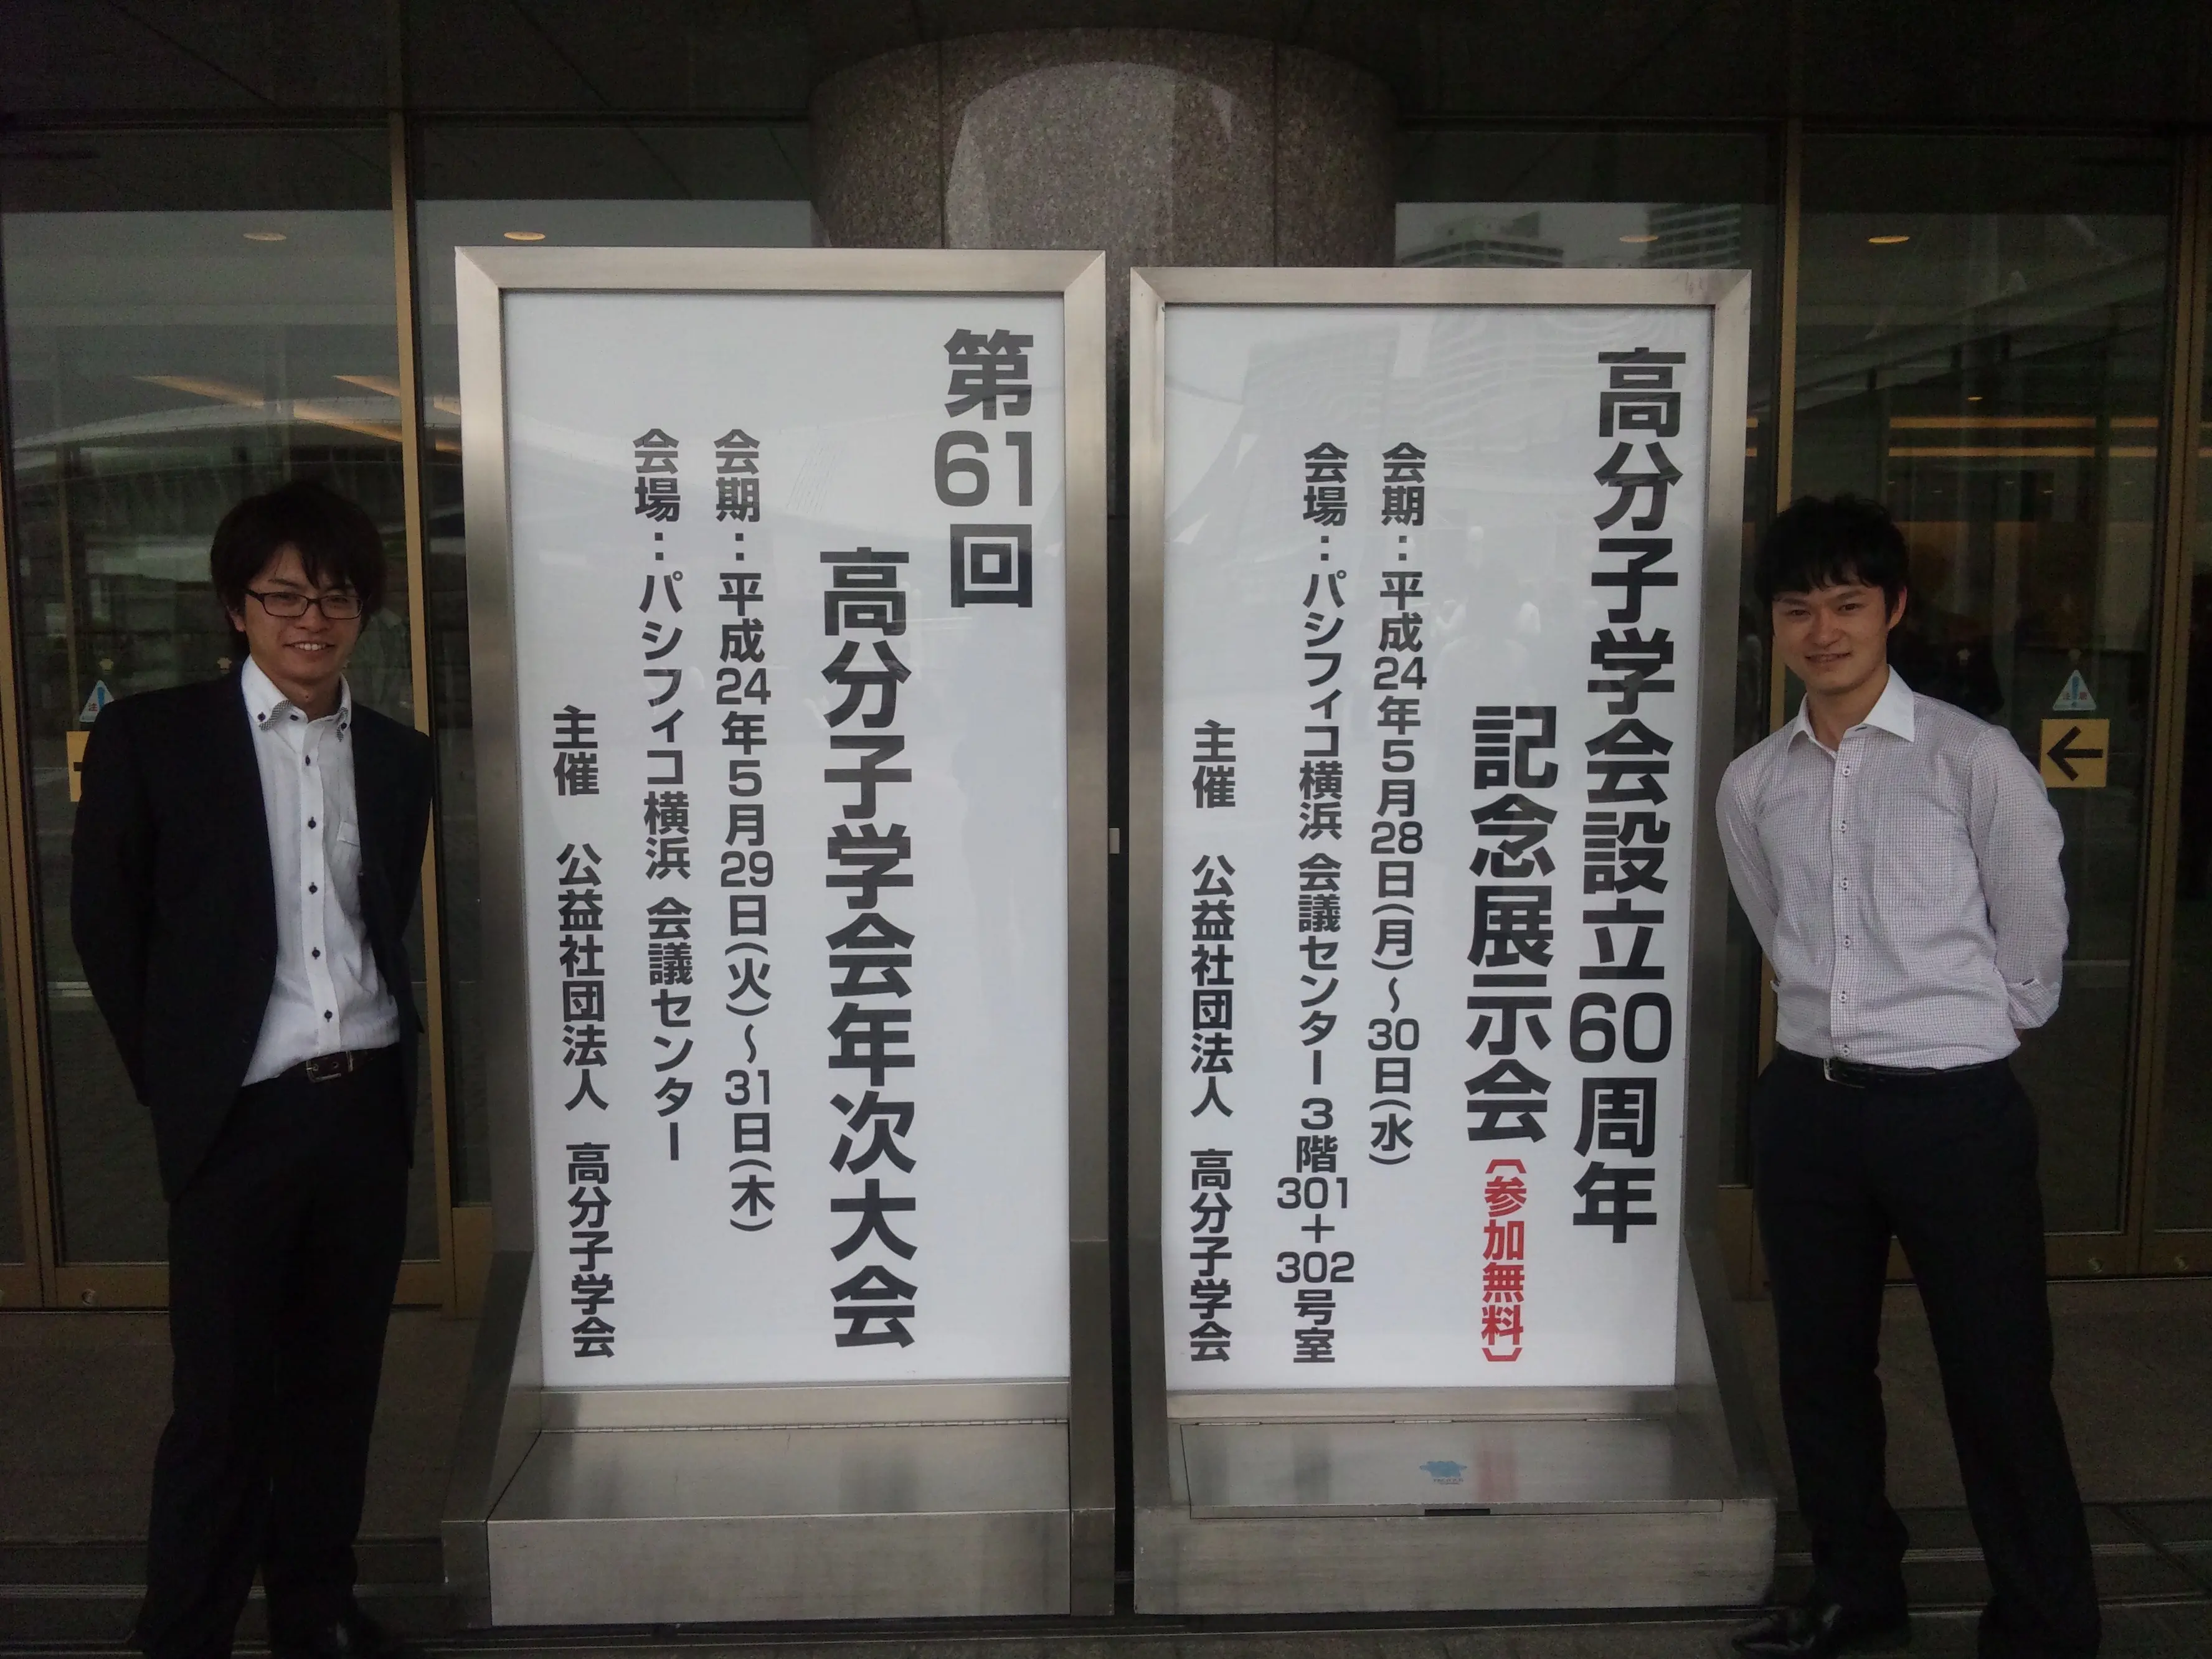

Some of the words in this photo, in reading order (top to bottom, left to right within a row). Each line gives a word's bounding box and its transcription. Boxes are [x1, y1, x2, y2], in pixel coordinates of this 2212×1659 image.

[933, 328, 1034, 609] 第61回
[552, 704, 600, 797] 主催
[1191, 718, 1237, 809] 主催
[1569, 346, 1687, 1245] 高分子学会設立60周年
[555, 842, 610, 1112] 公益社団法人
[645, 896, 694, 1161] 会議センター
[819, 546, 919, 1349] 高分子学会年次大会
[1189, 854, 1236, 1118] 公益社団法人
[1463, 705, 1559, 1144] 記念展示会
[565, 1141, 617, 1359] 高分子学会
[1188, 1148, 1234, 1363] 高分子学会
